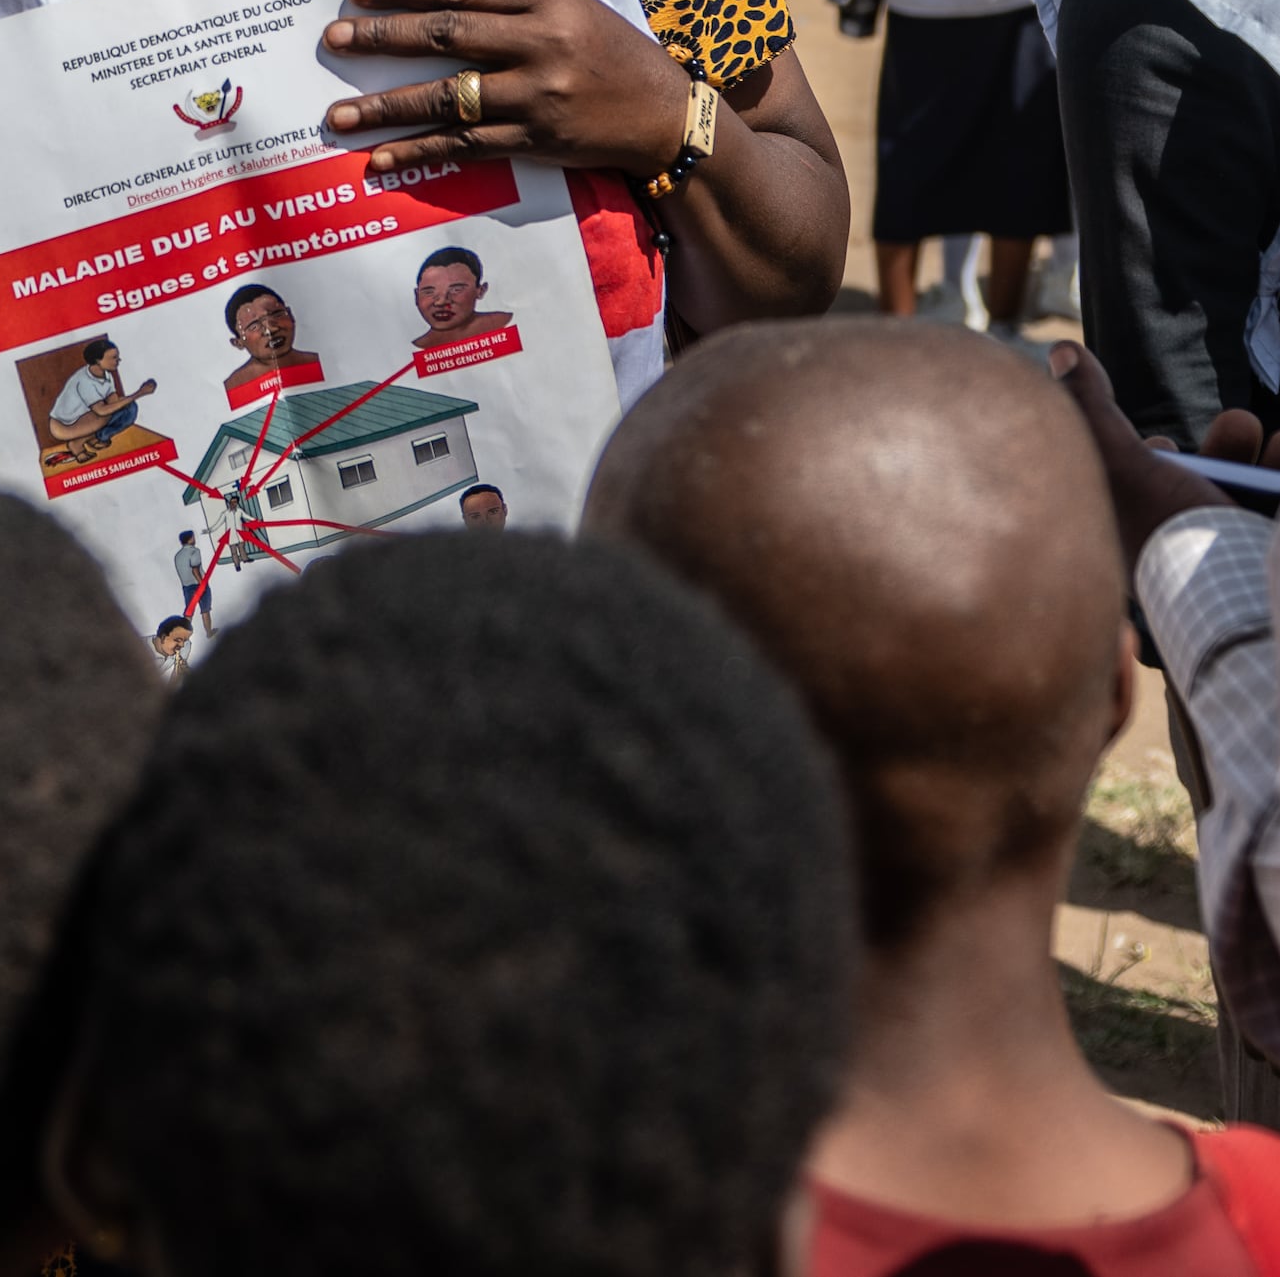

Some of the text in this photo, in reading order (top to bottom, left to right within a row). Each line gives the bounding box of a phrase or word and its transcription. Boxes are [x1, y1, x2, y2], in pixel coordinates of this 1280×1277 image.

[62, 41, 138, 72] REPUBLIQUE
[140, 10, 240, 49] DEMOCRATIQUE
[242, 5, 261, 19] DU
[91, 15, 294, 83] MINISTERE DE LA SANTE PUBLIQUE
[130, 43, 267, 90] SECRETARIAT GENERAL
[63, 125, 324, 209] DIRECTION GENERALE DE LUTTE CONTRE LA
[127, 140, 337, 207] Direction Hygiène et Salubrité Publique
[11, 159, 461, 300] MALADIE DUE AU VIRUS EBOLA
[96, 214, 399, 314] Signes et symptômes
[423, 332, 507, 363] SAIGNEMENTS DE NEZ
[426, 348, 494, 373] OU DES GENCIVES
[108, 451, 160, 474] SANGLANTES
